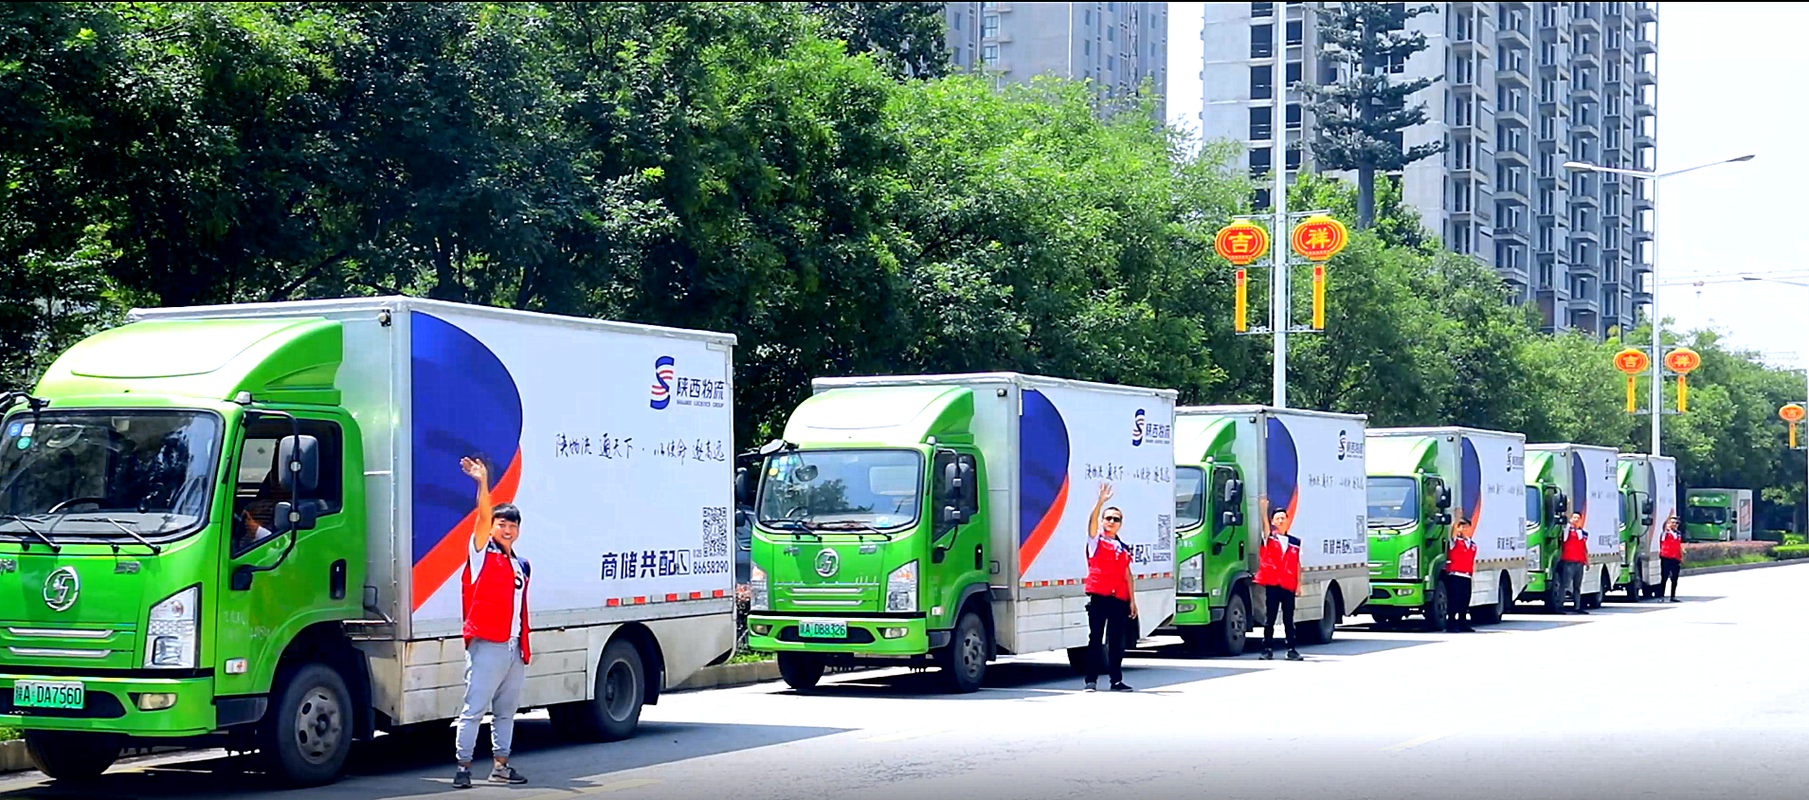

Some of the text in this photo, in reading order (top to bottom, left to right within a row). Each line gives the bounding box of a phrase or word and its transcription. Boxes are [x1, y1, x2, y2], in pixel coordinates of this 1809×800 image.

[1228, 232, 1253, 253] 吉
[1305, 227, 1331, 249] 祥
[1622, 355, 1639, 368] 吉
[676, 377, 725, 400] 陕西物流
[599, 432, 633, 459] 通天下
[601, 550, 677, 580] 商储共配
[36, 685, 82, 705] DA7560
